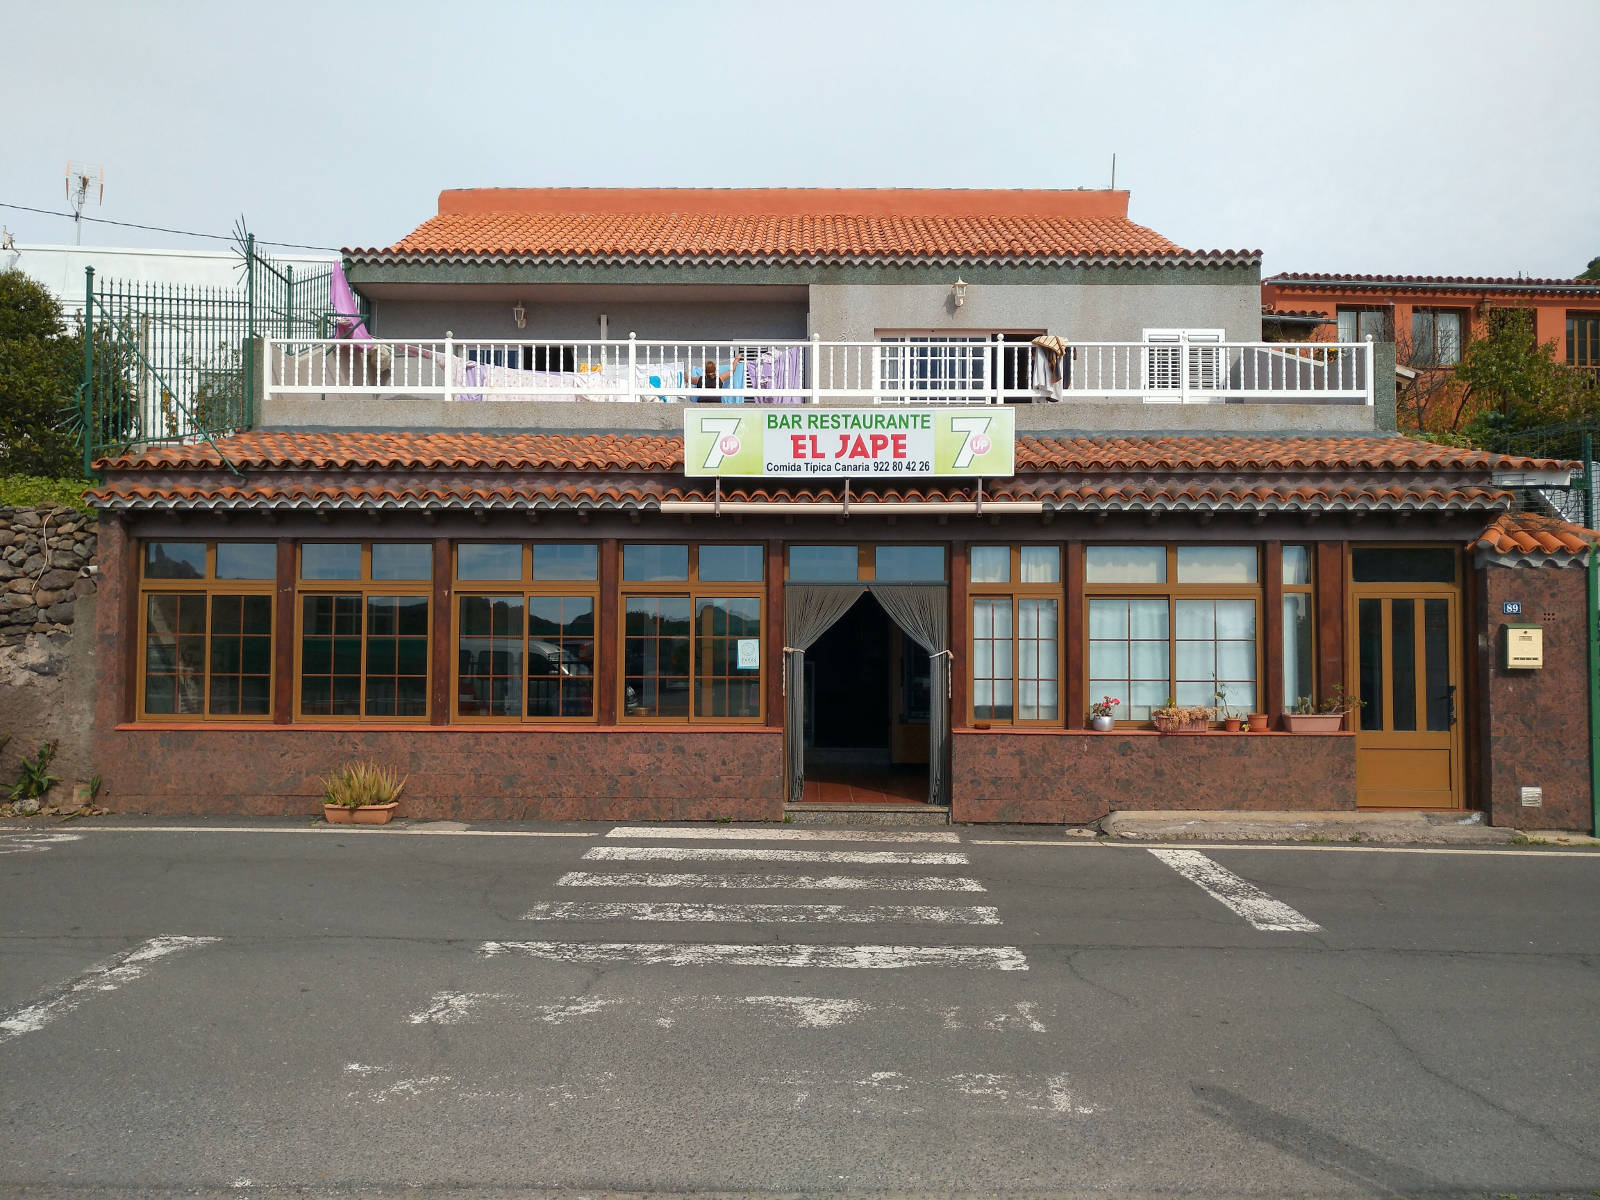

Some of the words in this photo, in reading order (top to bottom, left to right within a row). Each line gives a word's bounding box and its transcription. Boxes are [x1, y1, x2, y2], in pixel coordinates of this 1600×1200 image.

[767, 413, 803, 430] BAR
[807, 413, 931, 430] RESTAURANTE
[790, 434, 826, 459] EL
[834, 433, 907, 459] JAPE
[766, 462, 801, 472] Comida
[834, 462, 870, 472] Canaria
[873, 461, 890, 472] 922
[892, 461, 903, 472] 80
[905, 461, 917, 472] 42
[919, 461, 930, 472] 26
[1506, 604, 1519, 613] 89
